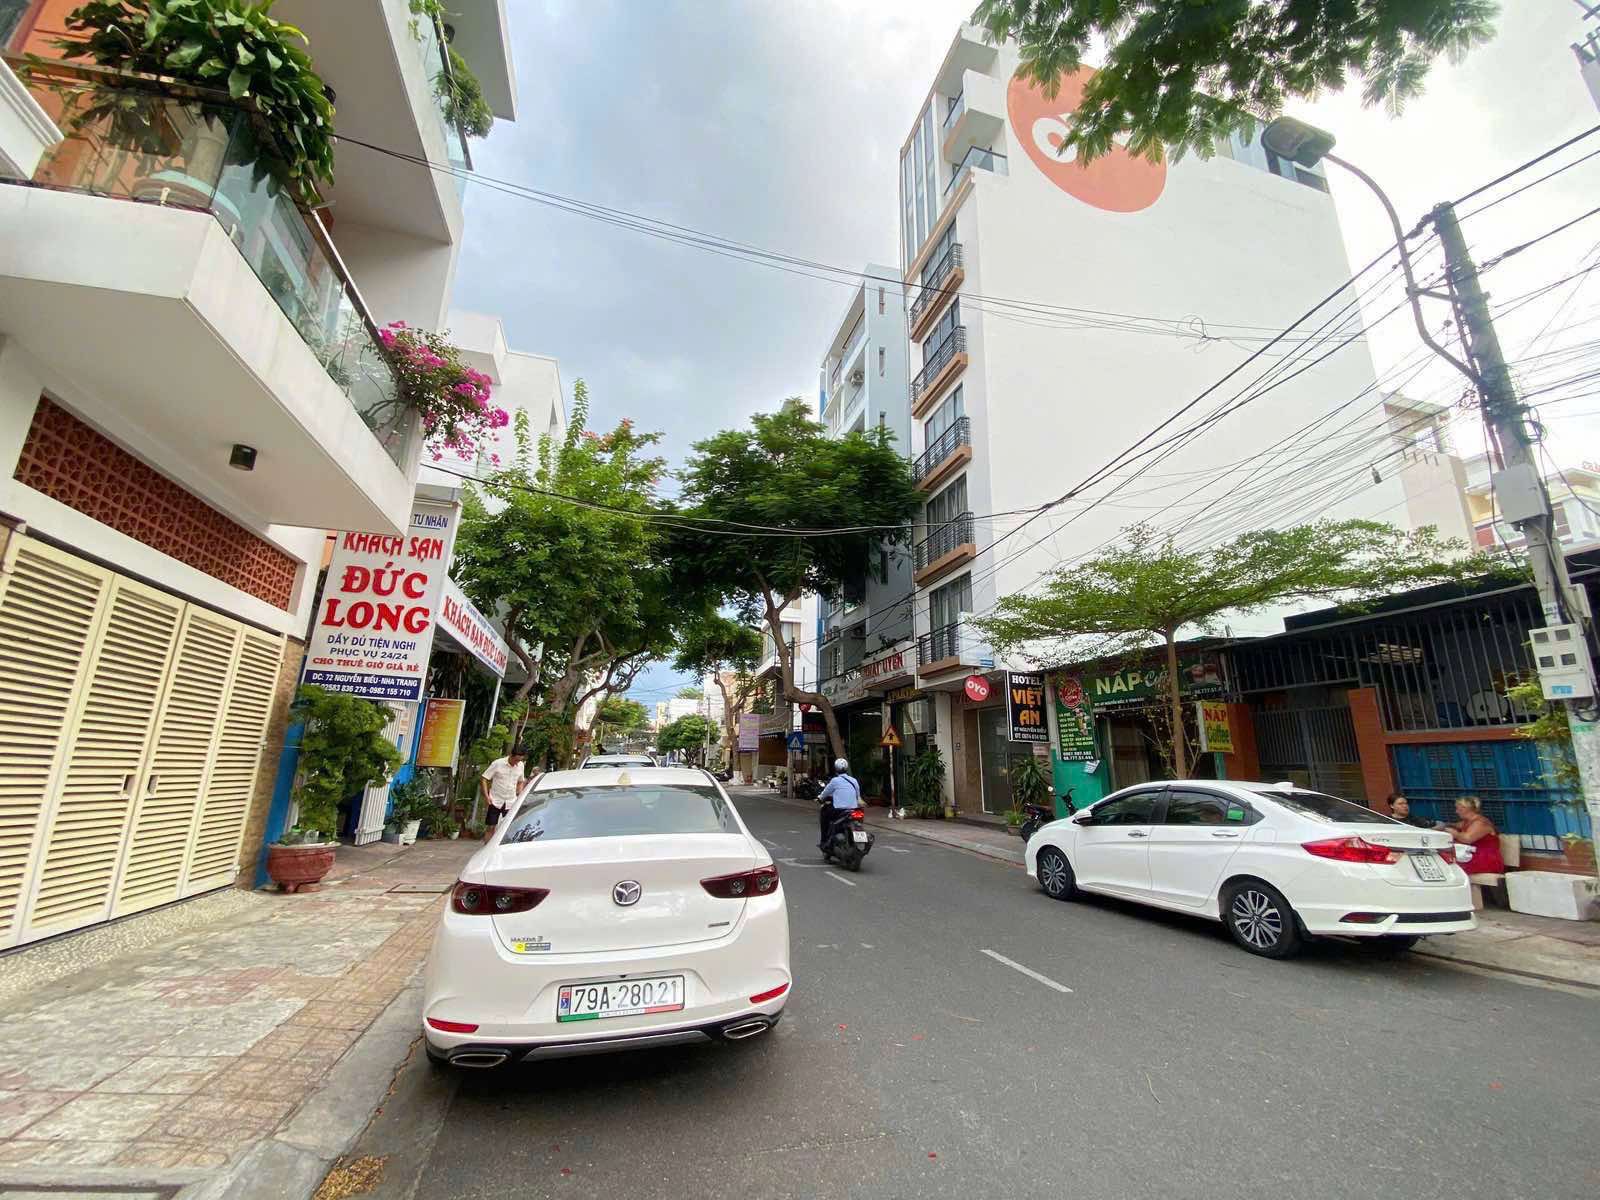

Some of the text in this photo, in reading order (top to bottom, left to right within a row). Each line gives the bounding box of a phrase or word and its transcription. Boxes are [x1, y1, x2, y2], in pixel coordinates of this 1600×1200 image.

[425, 514, 449, 528] NHÂN
[408, 536, 443, 563] SẠN
[340, 561, 428, 600] ĐỨC
[321, 598, 430, 634] LONG
[392, 640, 416, 651] NGHI
[312, 657, 334, 665] CHO
[330, 647, 360, 657] PHỤC
[381, 651, 408, 661] 24/24
[966, 680, 988, 696] OYO
[1011, 675, 1042, 686] HOTEL
[1013, 687, 1043, 708] VIỆT
